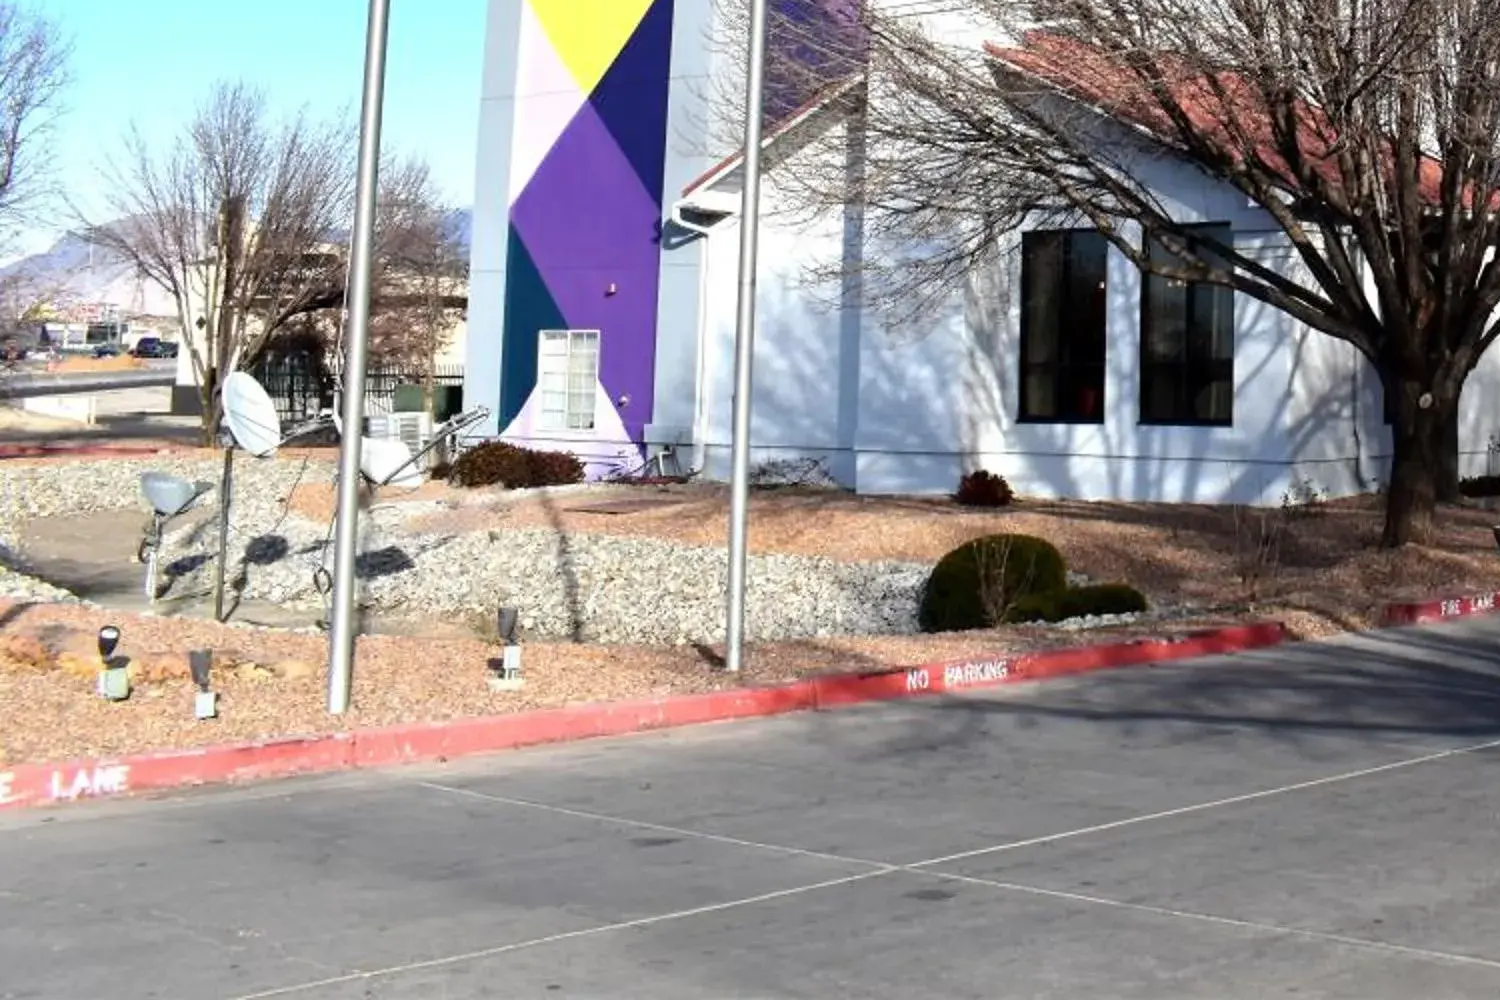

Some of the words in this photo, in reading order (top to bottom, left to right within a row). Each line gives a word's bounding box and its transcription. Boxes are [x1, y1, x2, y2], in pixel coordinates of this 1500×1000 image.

[906, 668, 929, 692] NO
[944, 660, 1008, 688] PARKING
[51, 765, 131, 801] LANE
